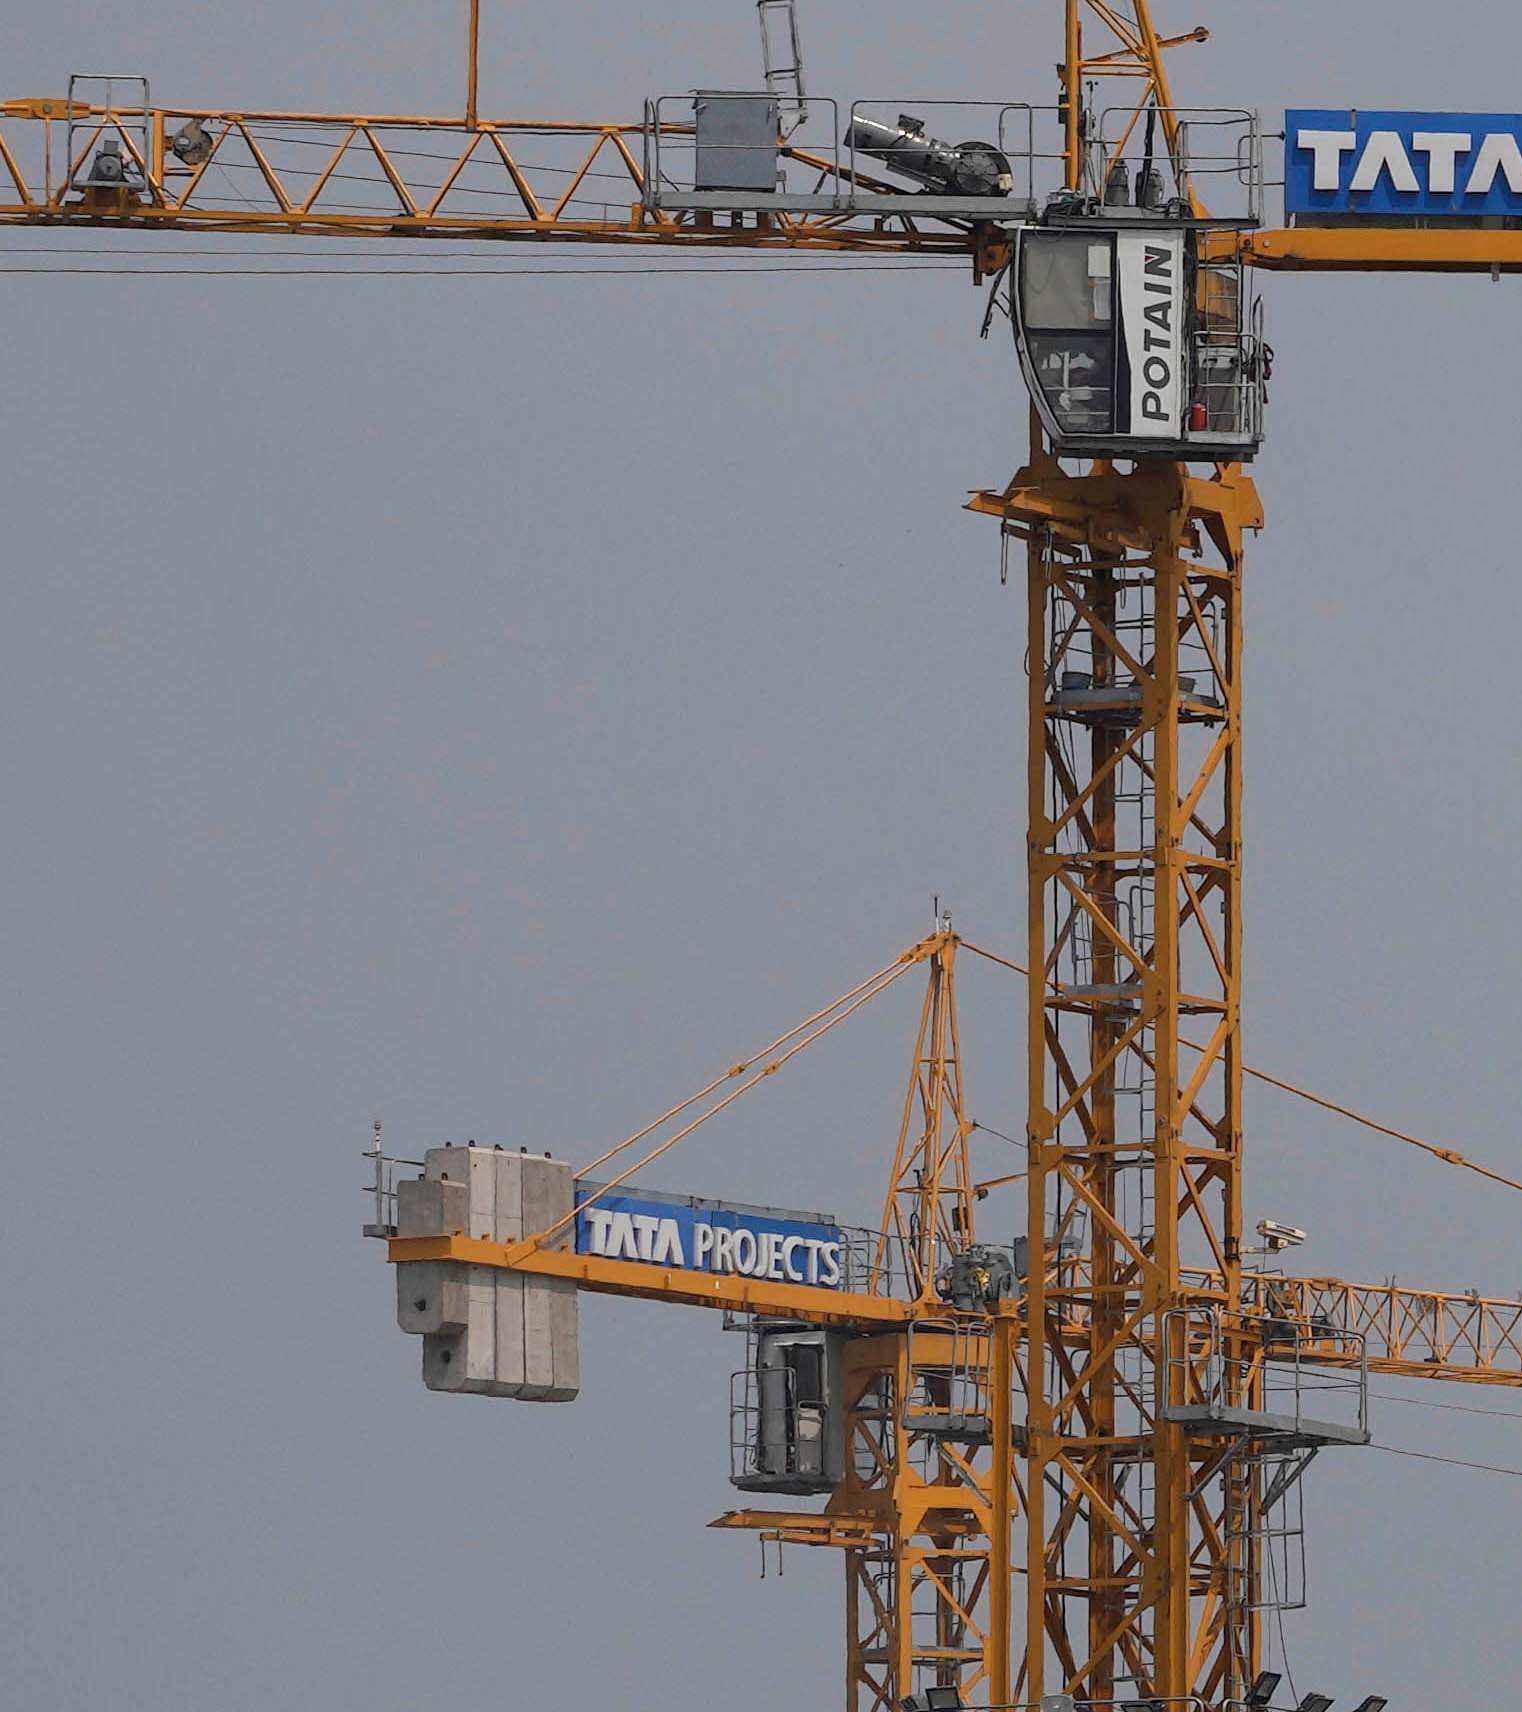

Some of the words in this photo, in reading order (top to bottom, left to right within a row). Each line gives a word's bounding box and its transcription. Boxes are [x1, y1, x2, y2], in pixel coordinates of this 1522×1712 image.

[1141, 245, 1172, 422] POTAIN
[585, 1208, 684, 1265] TATA
[694, 1223, 840, 1285] PROJECTS
